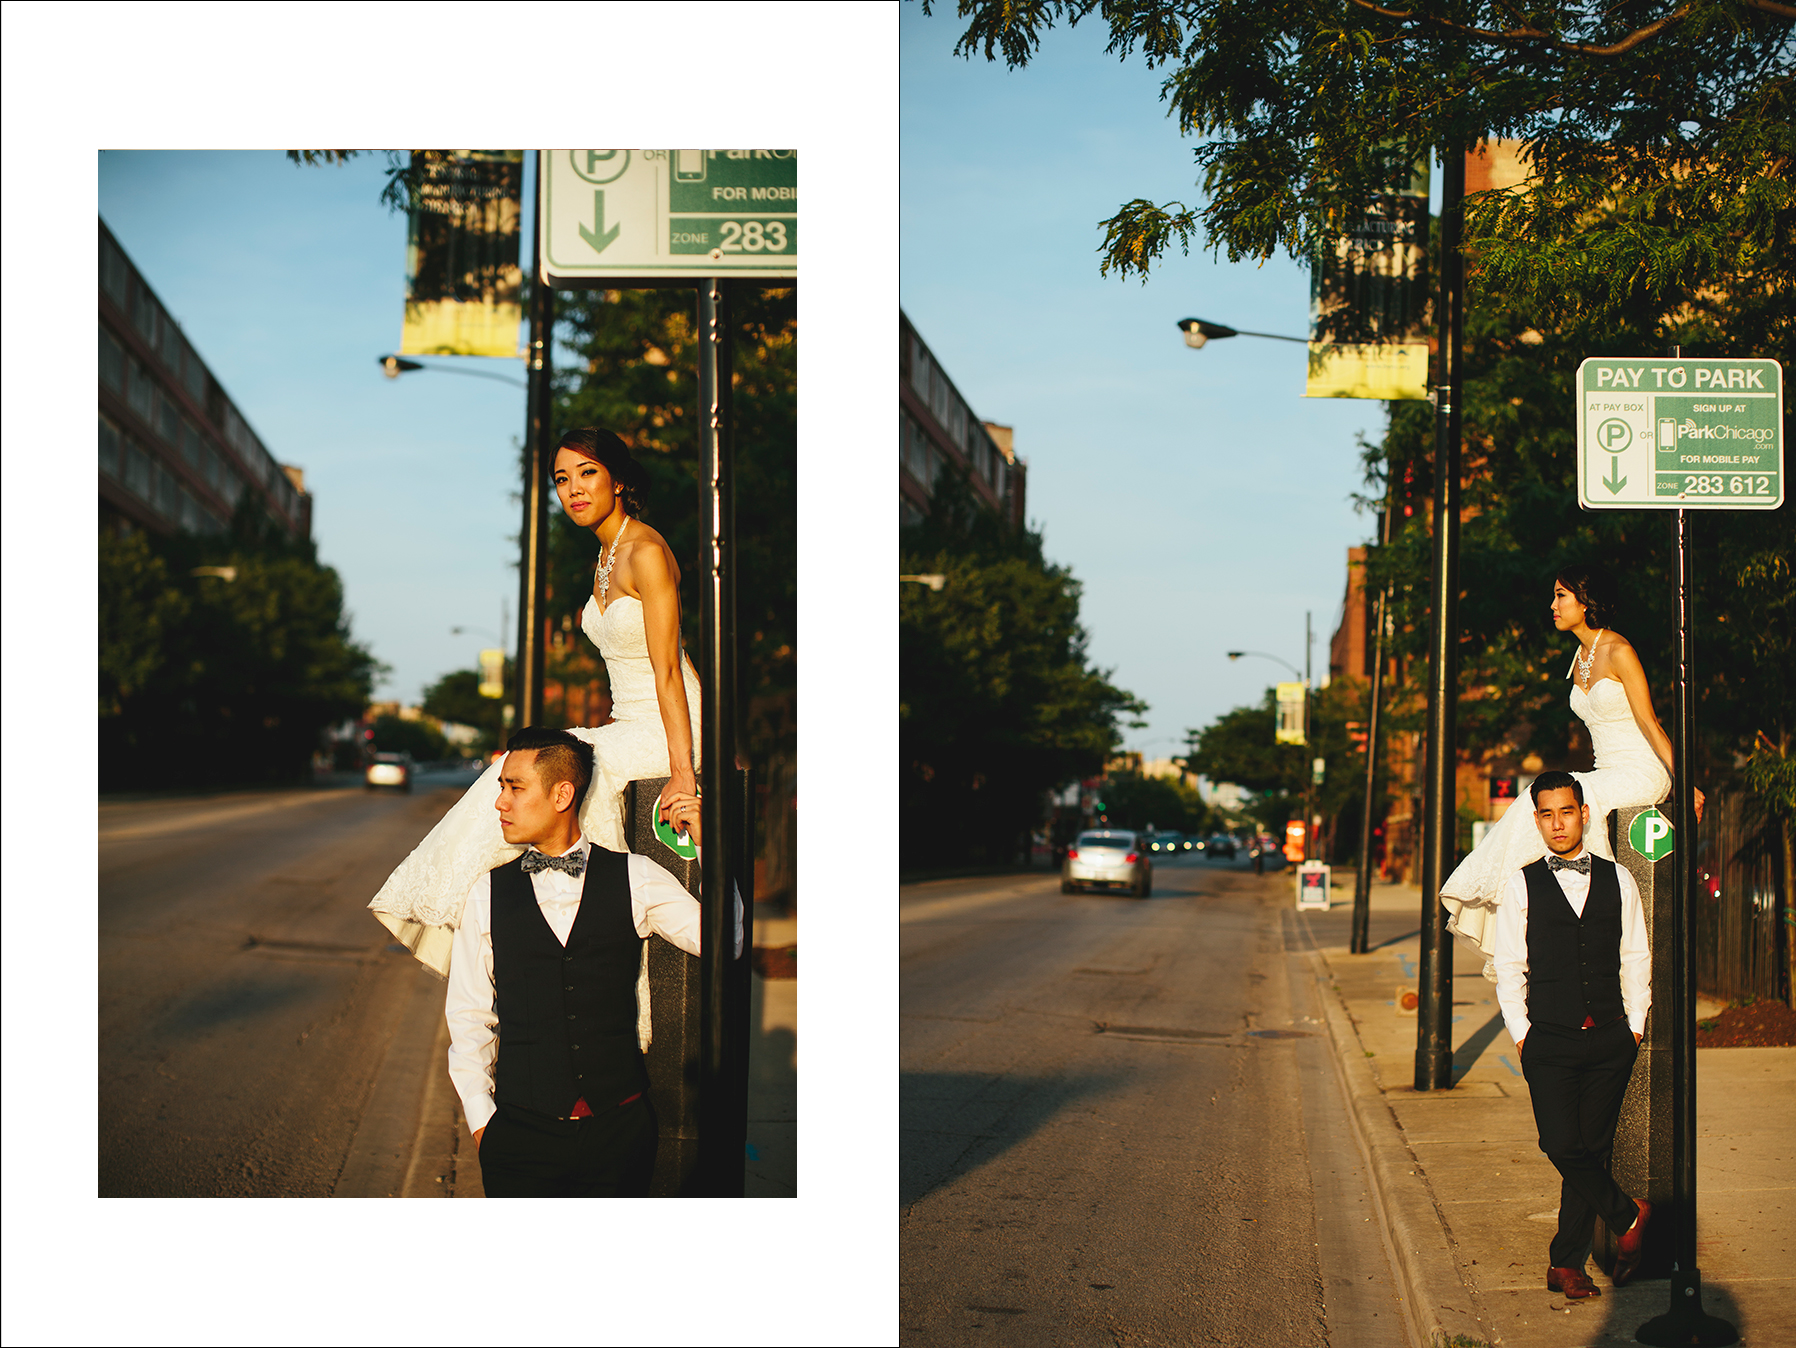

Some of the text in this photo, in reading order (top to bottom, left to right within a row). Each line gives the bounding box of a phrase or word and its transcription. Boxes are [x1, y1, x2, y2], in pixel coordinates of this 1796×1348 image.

[712, 186, 797, 200] FOR MOBI
[671, 220, 788, 252] ZONE 283
[1596, 366, 1765, 389] PAY TO PARK
[1589, 403, 1644, 412] AT PAY BOX
[1693, 404, 1747, 413] SIGN UP AT
[1639, 431, 1654, 440] OR
[1677, 424, 1775, 443] ParkChicago
[1680, 455, 1761, 464] FOR MOBILE PAY
[1657, 475, 1770, 495] ZONE 283 612
[1645, 816, 1670, 853] P
